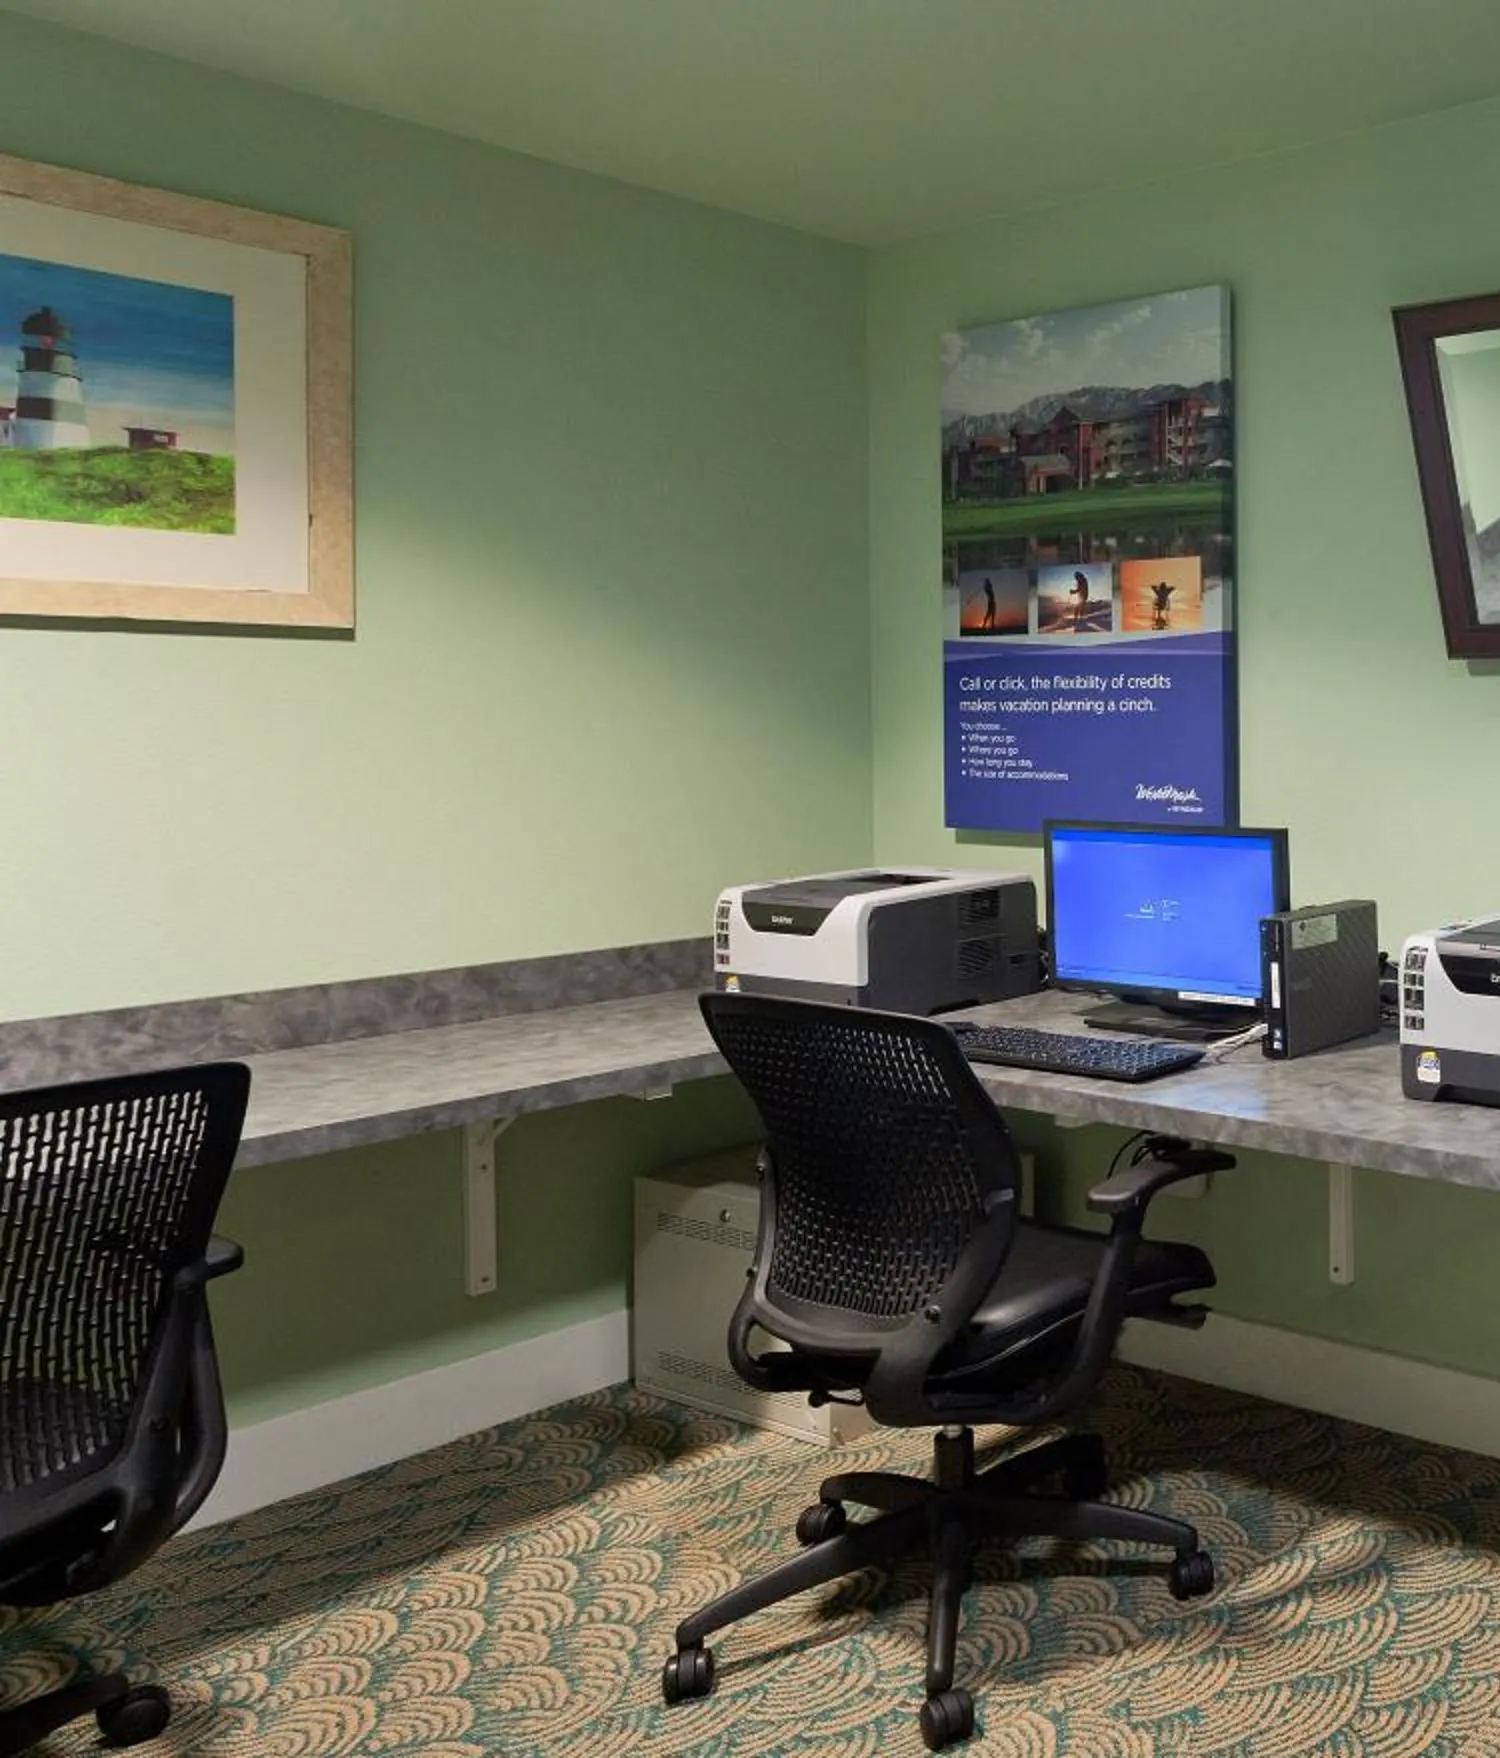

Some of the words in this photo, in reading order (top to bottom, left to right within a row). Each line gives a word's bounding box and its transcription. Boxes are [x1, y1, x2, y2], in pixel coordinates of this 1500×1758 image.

[959, 676, 981, 691] Call
[984, 679, 997, 691] or
[1000, 675, 1028, 692] click,
[1031, 675, 1050, 690] the
[1053, 675, 1107, 692] flexibility
[1111, 674, 1125, 689] of
[1127, 674, 1171, 690] credits
[959, 698, 997, 713] makes
[1000, 698, 1049, 713] vacation
[1051, 698, 1104, 715] planning
[1107, 701, 1116, 712] a
[1119, 697, 1158, 713] cinch.
